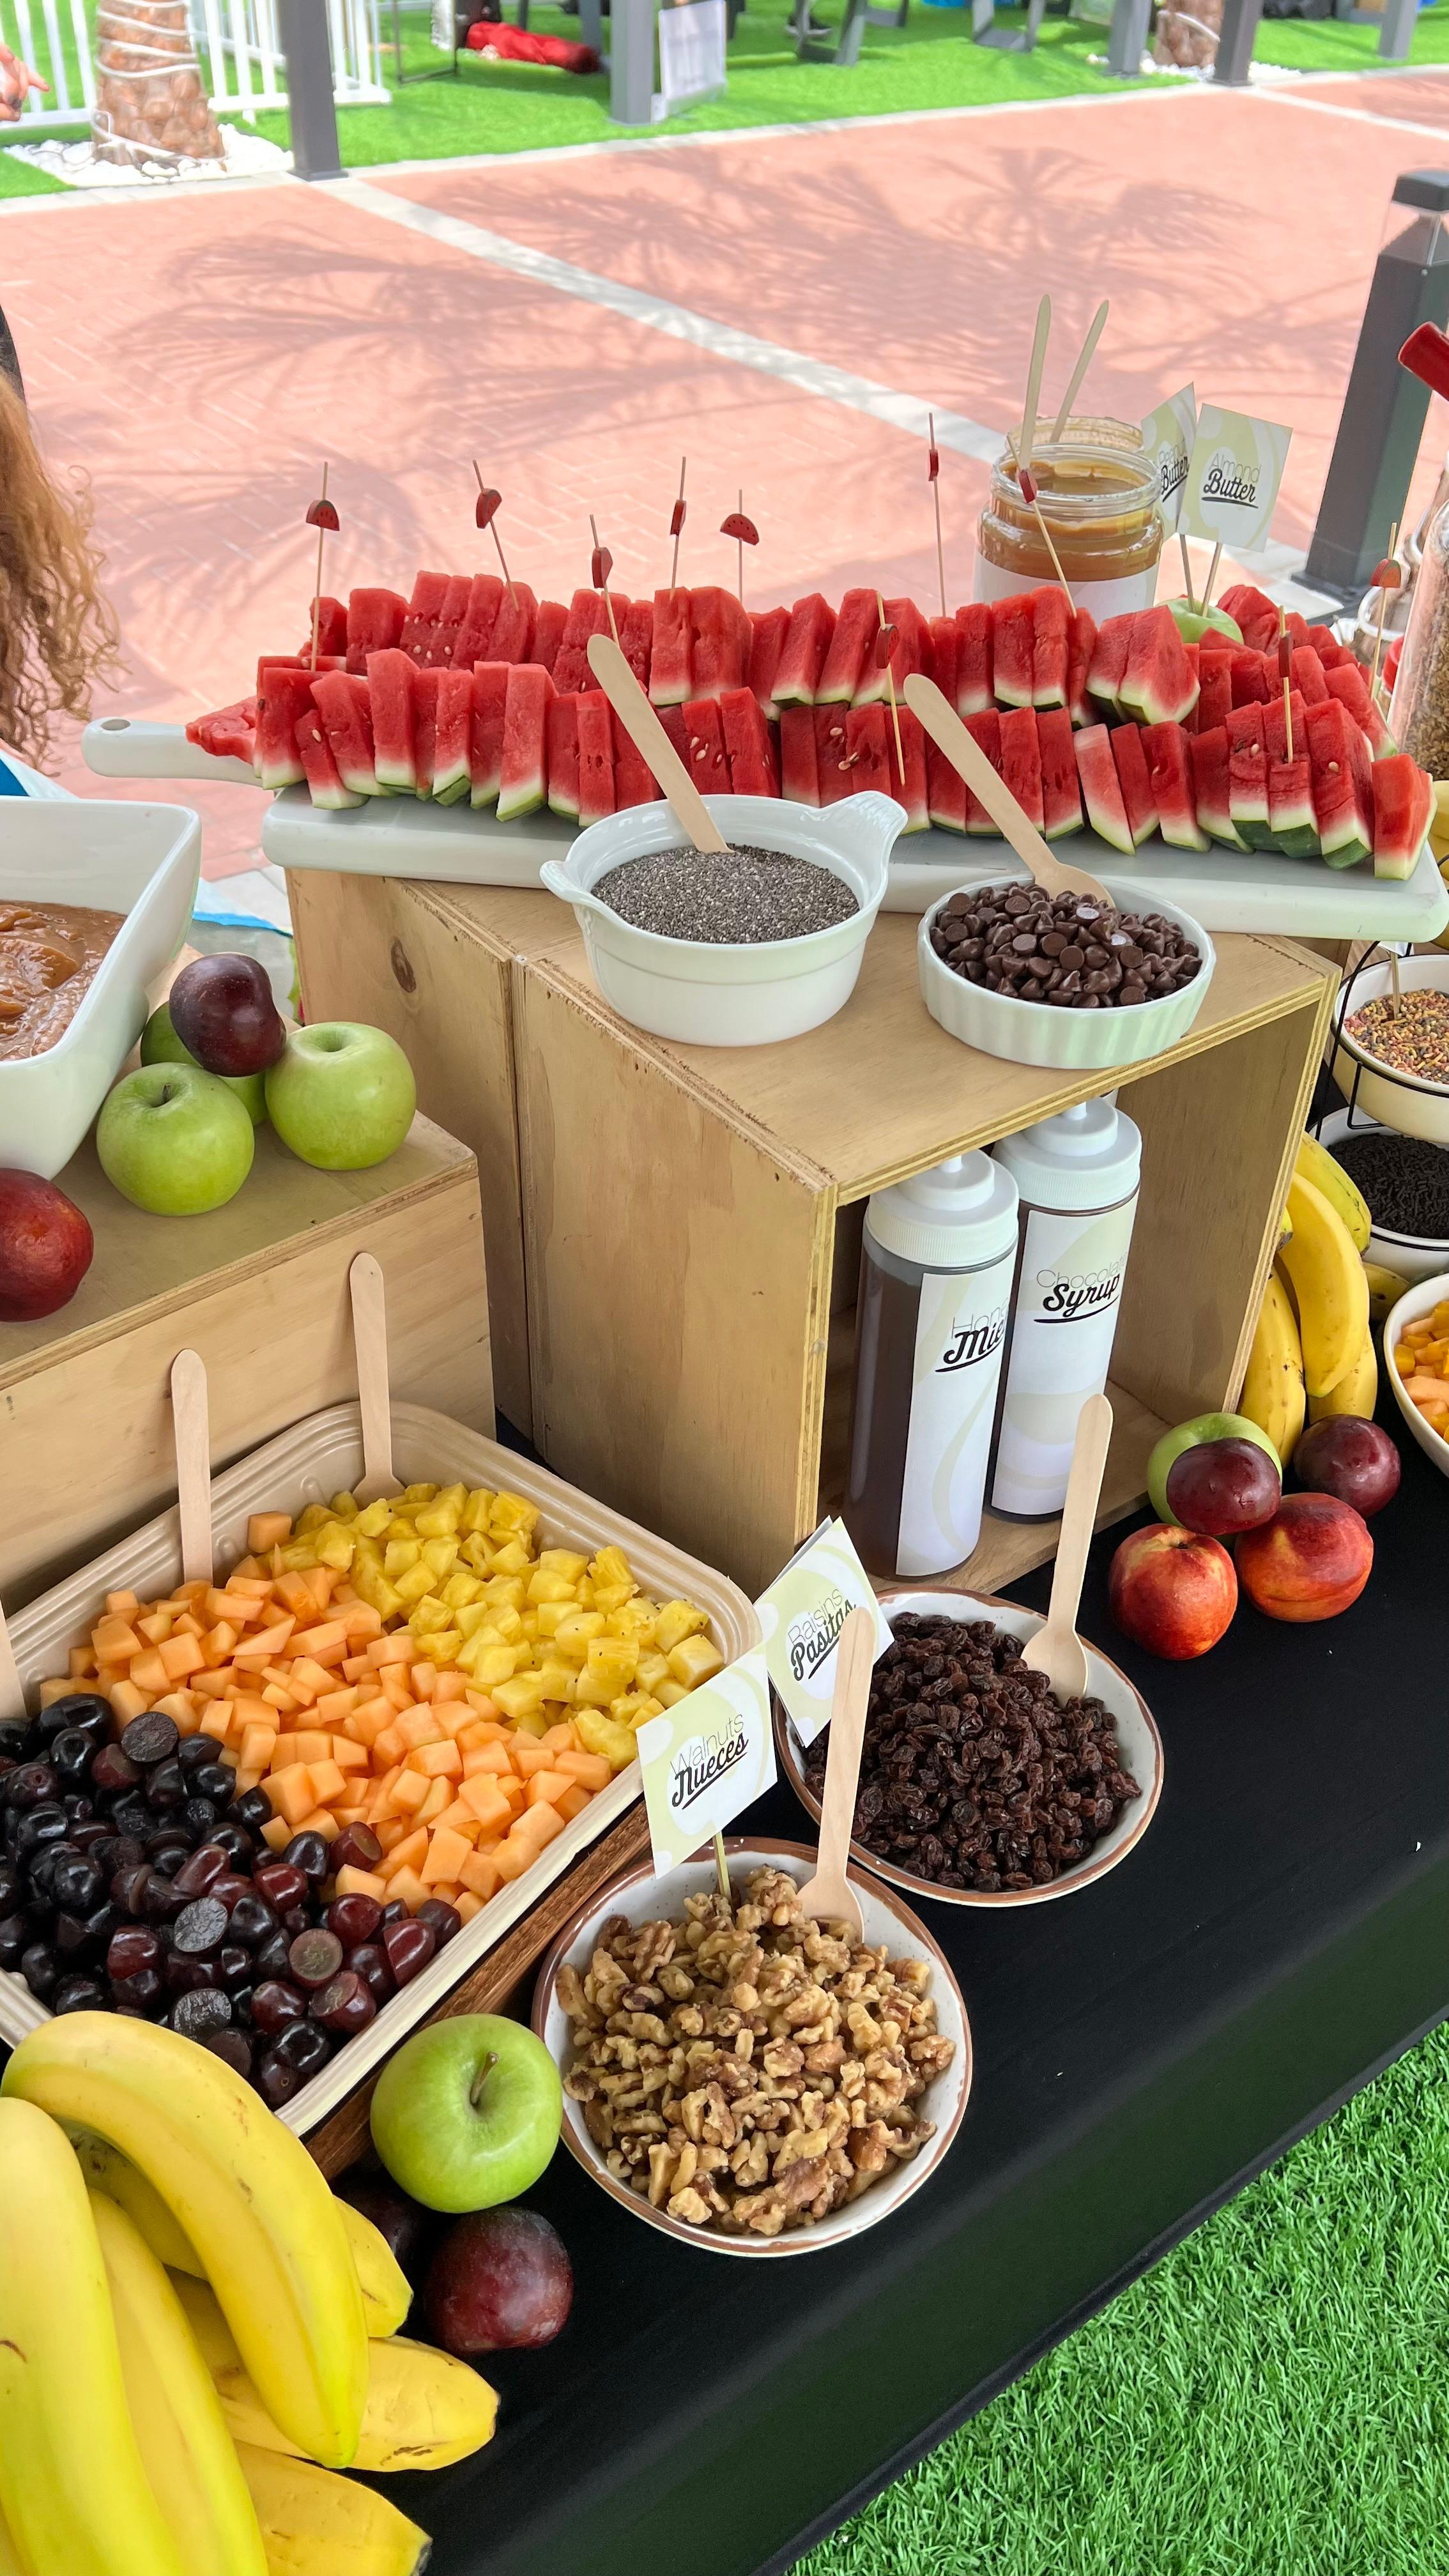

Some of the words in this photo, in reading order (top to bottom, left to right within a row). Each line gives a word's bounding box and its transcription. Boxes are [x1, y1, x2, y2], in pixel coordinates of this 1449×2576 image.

[1161, 456, 1190, 494] Butter
[1204, 468, 1256, 503] Butter
[1209, 453, 1261, 483] Almond
[1043, 1273, 1120, 1317] Syrup
[951, 1297, 1008, 1339] Hone
[943, 1319, 1006, 1364] Mie
[788, 1589, 843, 1646] Raisins
[790, 1599, 856, 1682] Pasitas
[670, 1713, 743, 1773] Walnuts
[671, 1733, 749, 1807] Nueces
